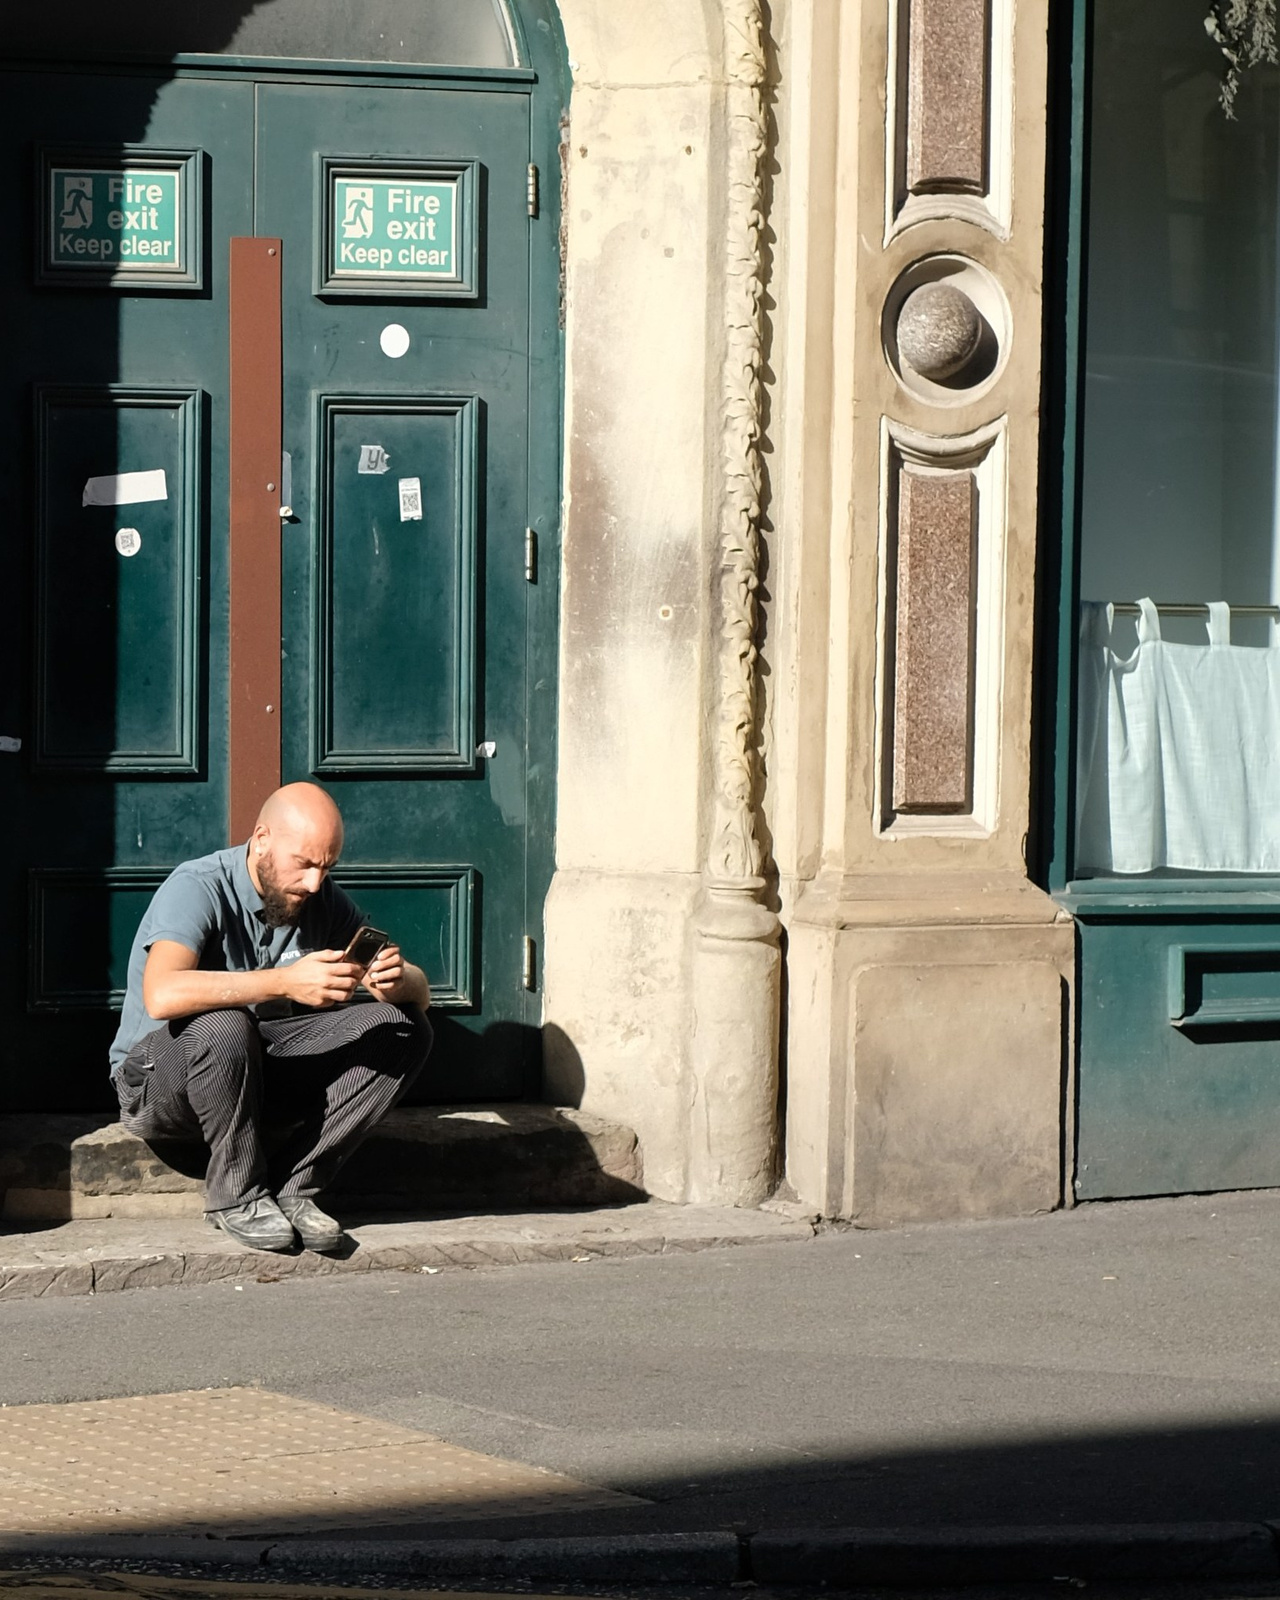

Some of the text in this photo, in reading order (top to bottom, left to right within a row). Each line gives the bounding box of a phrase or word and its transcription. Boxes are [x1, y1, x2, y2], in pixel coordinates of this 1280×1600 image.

[108, 178, 163, 204] Fire
[387, 188, 440, 215] Fire
[107, 206, 159, 230] exit
[386, 216, 436, 240] exit
[60, 233, 172, 259] Keep clear
[340, 243, 449, 269] Keep clear
